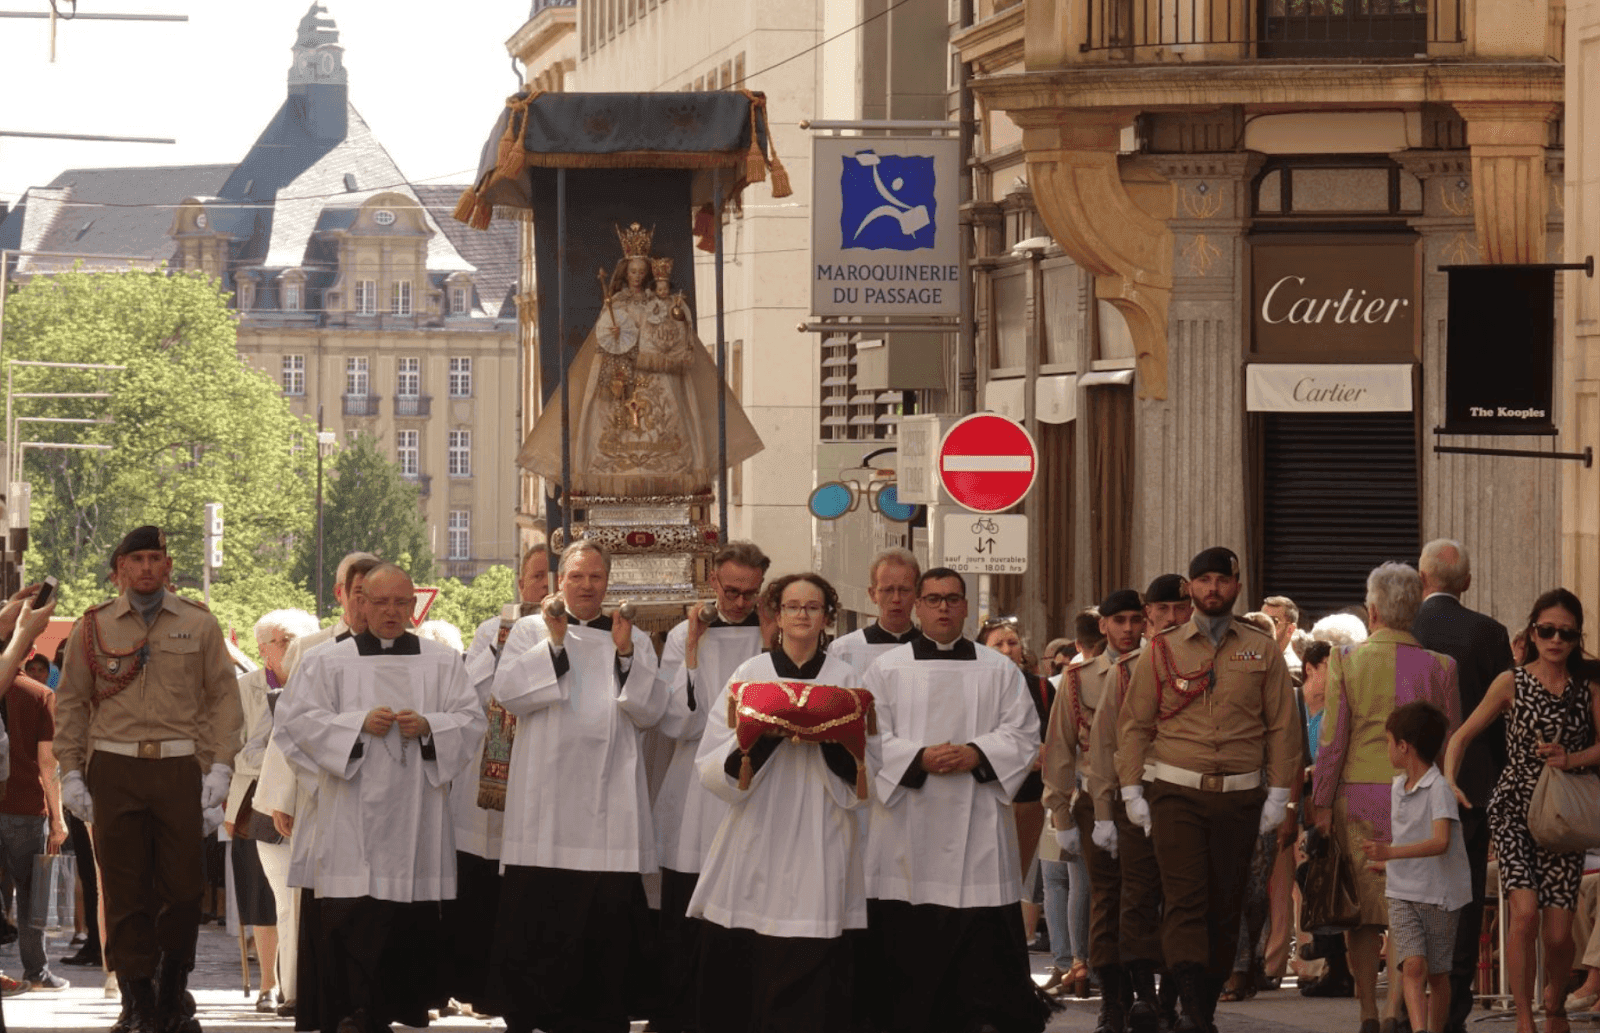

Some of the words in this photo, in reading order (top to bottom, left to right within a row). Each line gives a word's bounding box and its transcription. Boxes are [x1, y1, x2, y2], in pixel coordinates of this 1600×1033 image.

[817, 264, 958, 281] MAROQUINERIE
[834, 288, 858, 304] DU
[865, 288, 942, 304] PASSAGE
[1262, 275, 1409, 324] Cartier
[1293, 376, 1367, 402] Cartier
[1470, 407, 1494, 417] The
[1497, 407, 1545, 419] Kooples
